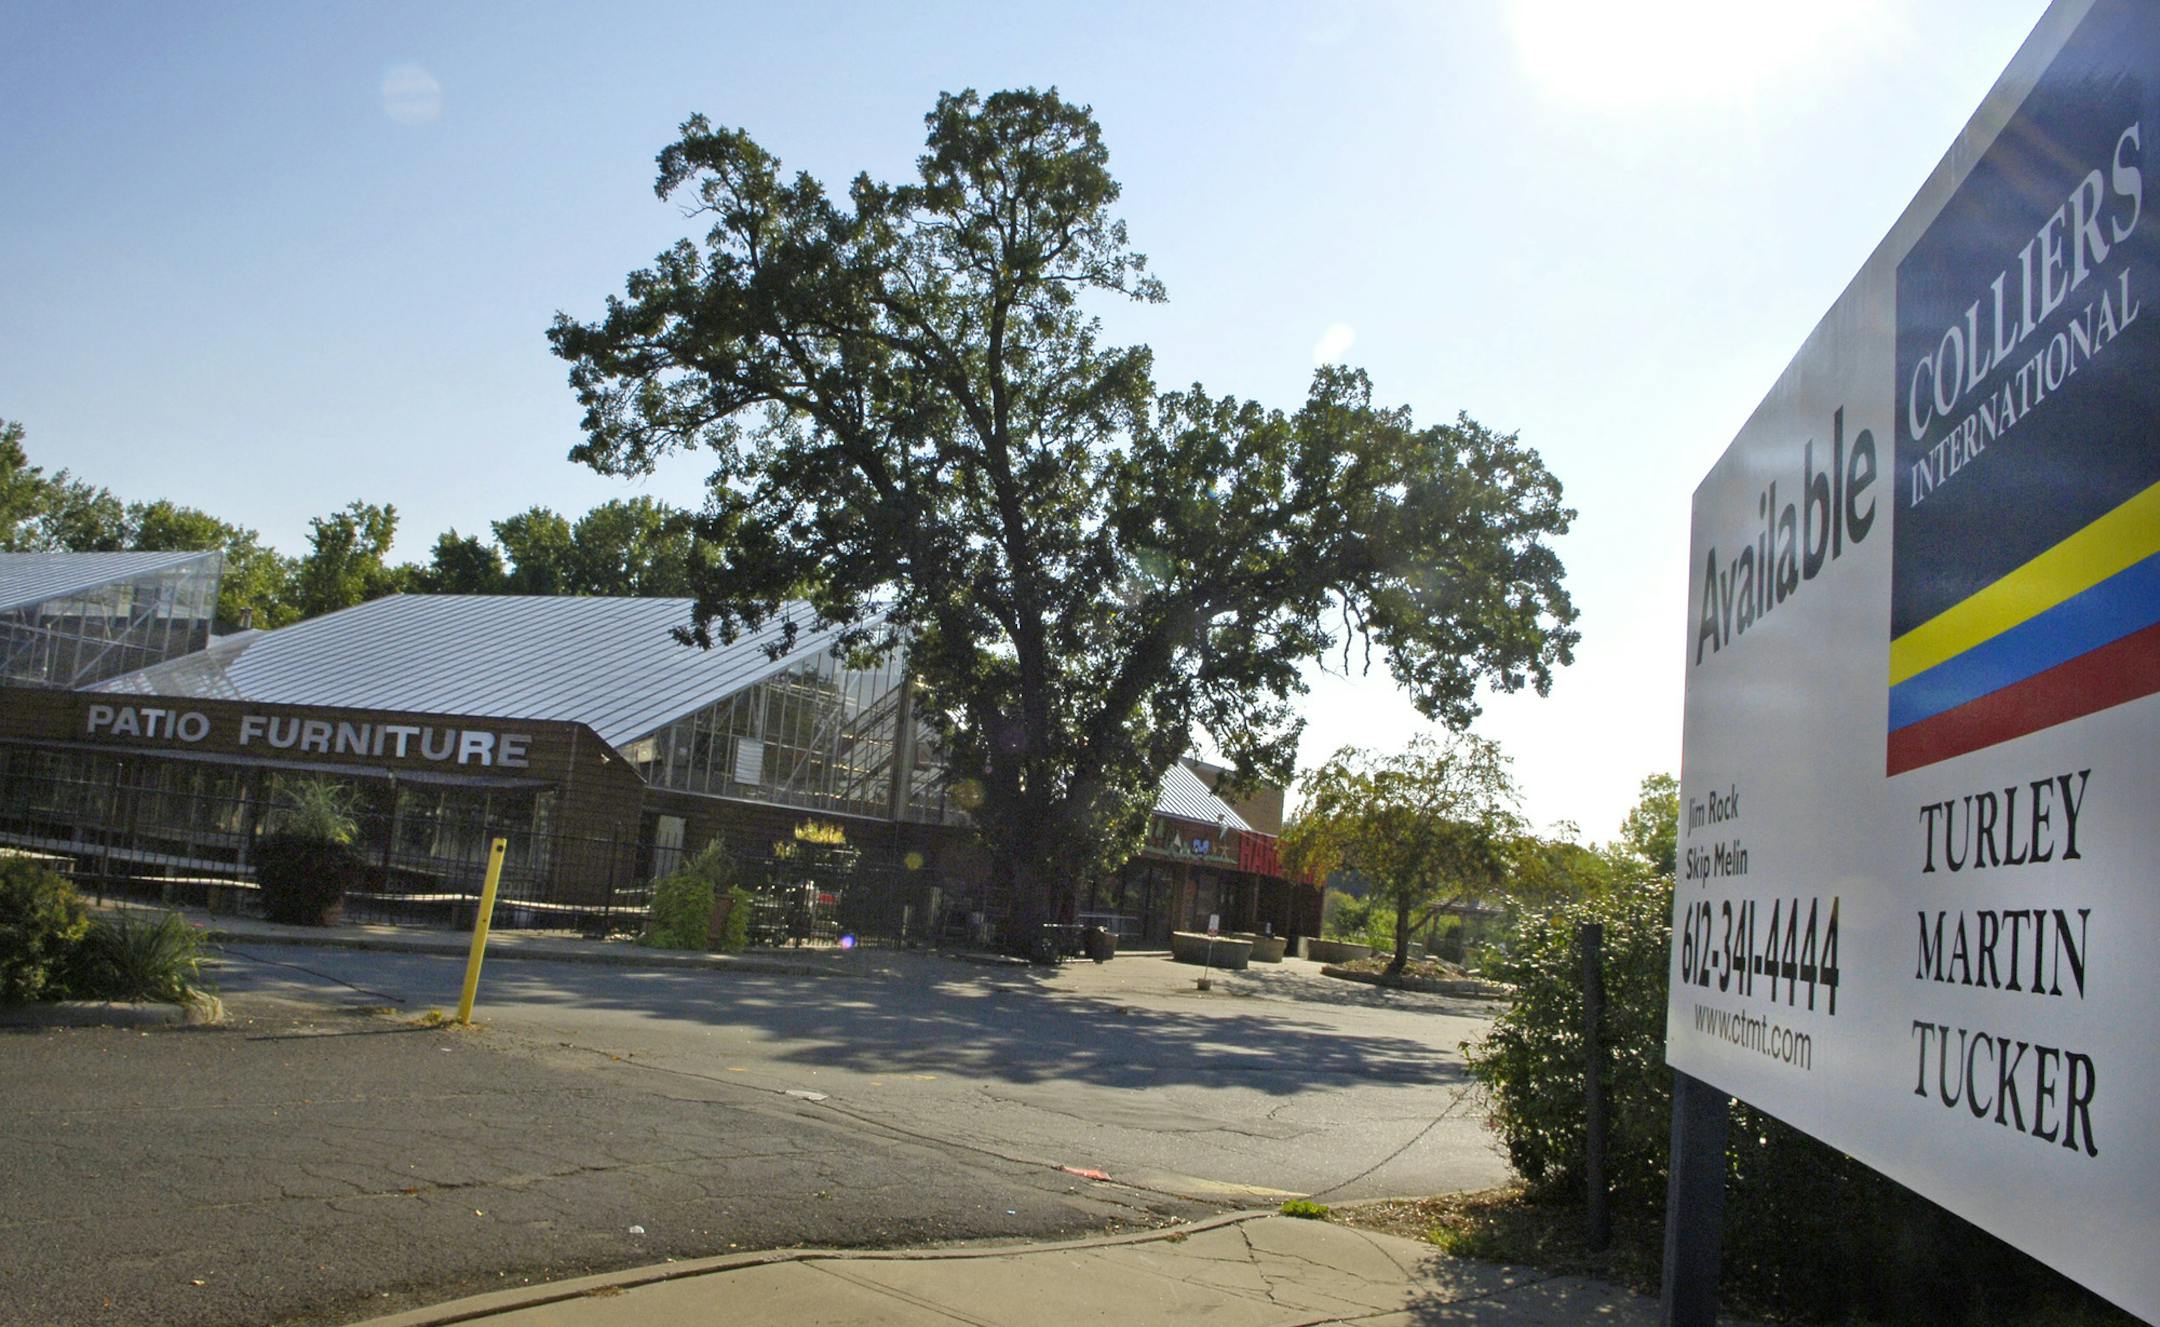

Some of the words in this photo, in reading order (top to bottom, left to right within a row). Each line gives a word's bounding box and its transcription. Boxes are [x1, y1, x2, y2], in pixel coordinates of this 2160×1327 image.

[1908, 121, 2143, 441] COLLIERS
[1910, 267, 2139, 508] INTERNATIONAL
[1696, 405, 1876, 666] Available
[87, 705, 211, 743] PATIO
[239, 716, 532, 768] FURNITURE
[1687, 799, 1705, 837] Jim
[1708, 784, 1739, 825] Rock
[1919, 768, 2091, 873] TURLEY
[1686, 847, 1711, 888] Skip
[1714, 839, 1748, 877] Melin
[1682, 896, 1840, 1016] 612-341-4444
[1915, 908, 2091, 999] MARTIN
[1695, 1003, 1812, 1070] www.ctmt.com
[1912, 1020, 2099, 1158] TUCKER
